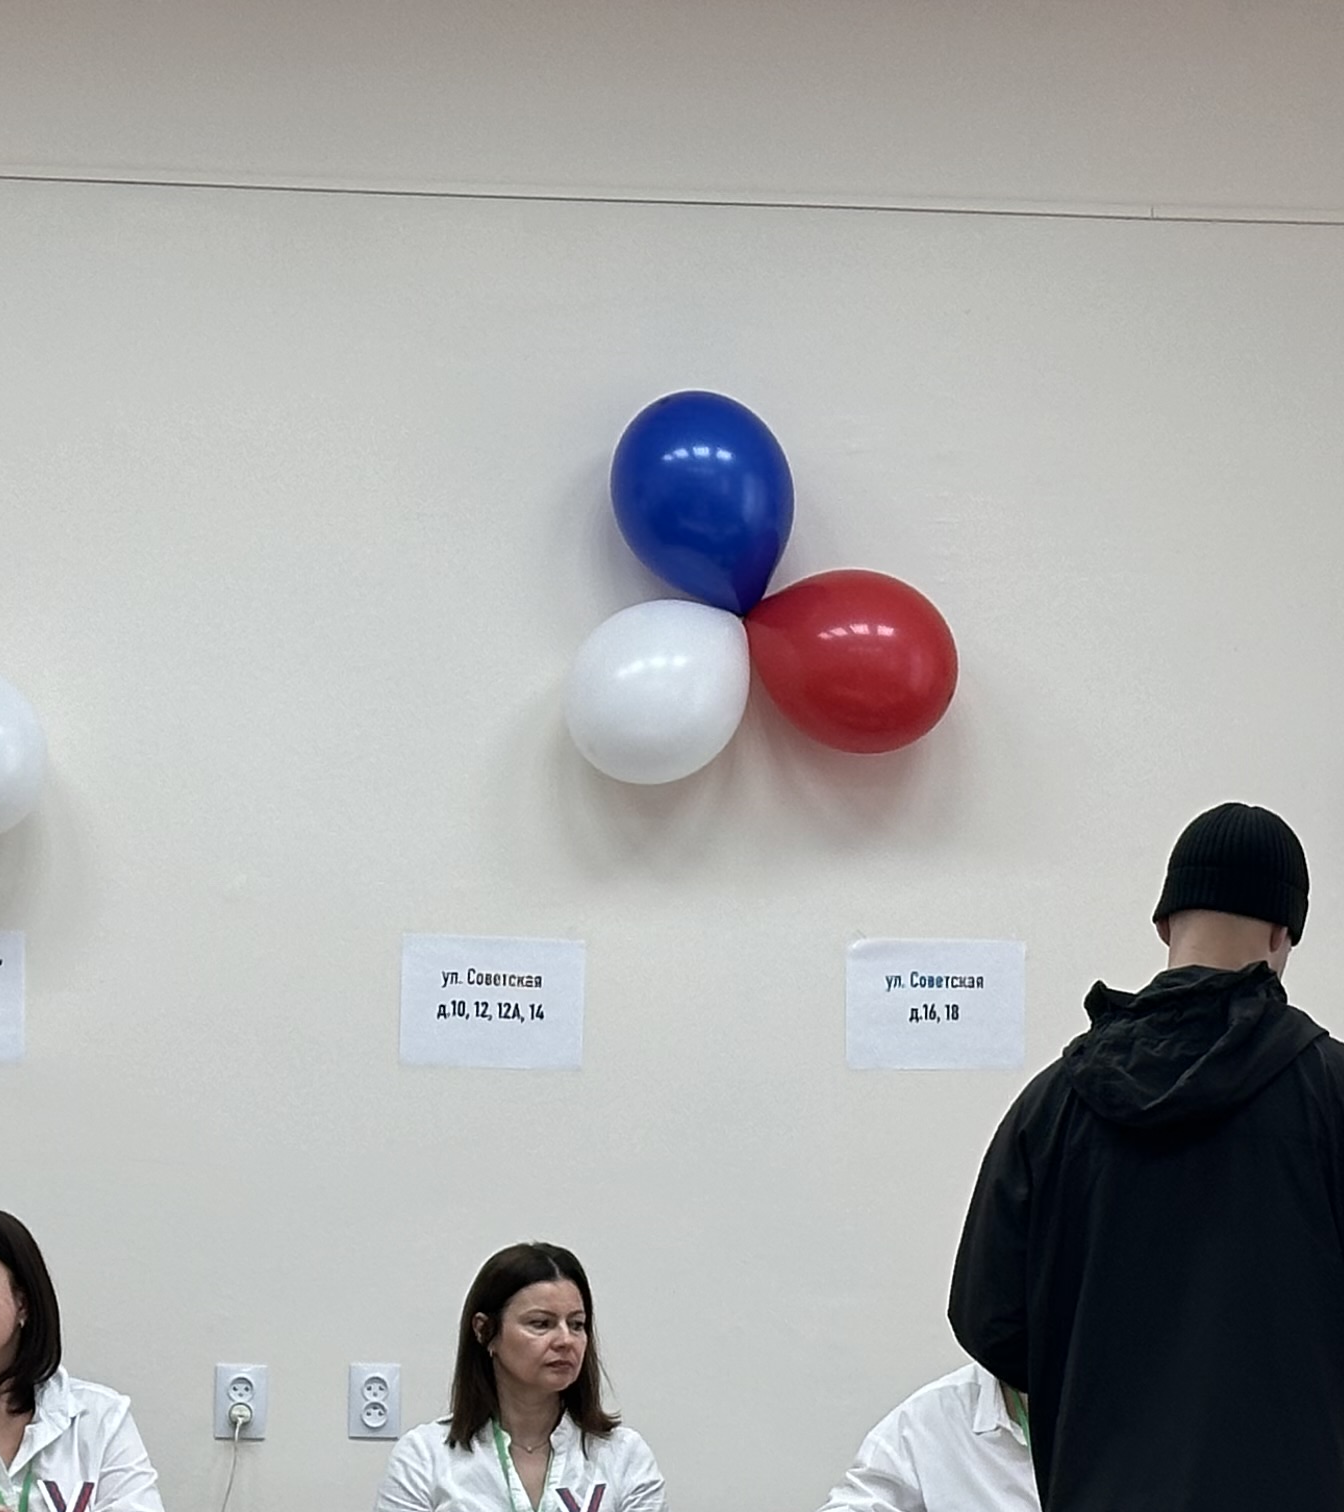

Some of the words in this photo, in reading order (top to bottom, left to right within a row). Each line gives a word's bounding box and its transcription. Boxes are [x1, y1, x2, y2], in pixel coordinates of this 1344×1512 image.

[441, 971, 463, 989] ул.
[467, 968, 542, 988] Советская
[885, 975, 905, 992] ул.
[910, 971, 984, 989] Советская
[437, 1000, 470, 1020] д.10,
[474, 1001, 493, 1021] 12,
[528, 1003, 544, 1020] 14
[909, 1003, 941, 1024] д.16,
[945, 1004, 959, 1021] 18
